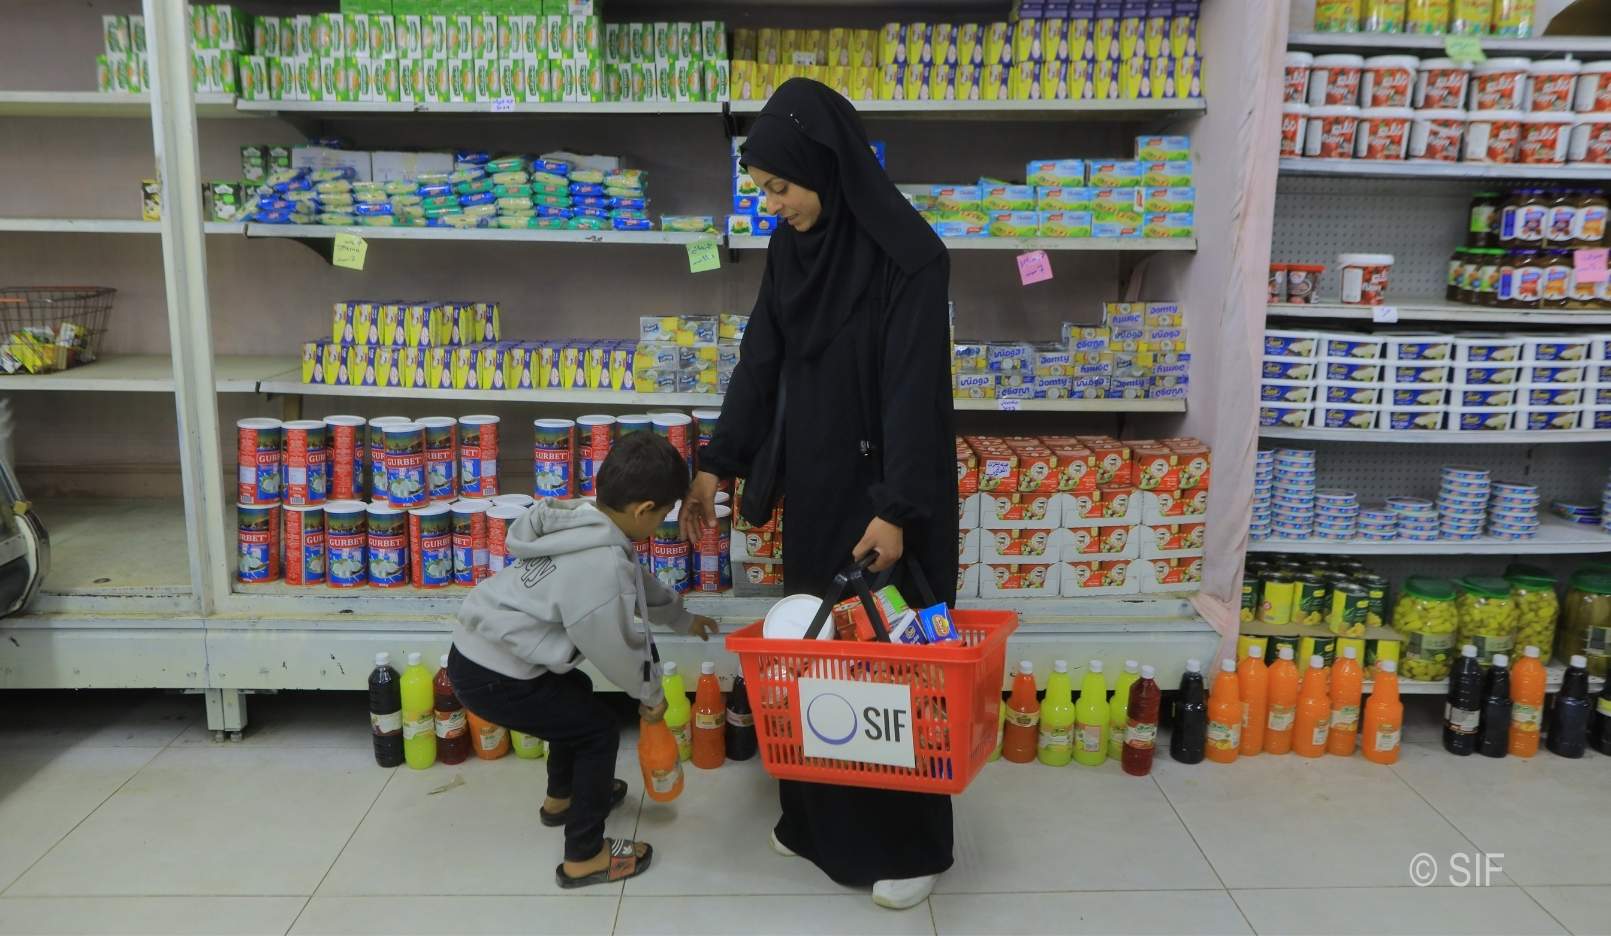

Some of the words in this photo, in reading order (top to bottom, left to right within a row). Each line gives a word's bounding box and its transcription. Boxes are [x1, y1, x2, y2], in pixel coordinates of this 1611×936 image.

[387, 457, 421, 465] GURBET
[329, 537, 364, 547] GURBET
[368, 538, 401, 547] GURBET
[655, 546, 687, 554] GURBET
[863, 706, 906, 742] SIF
